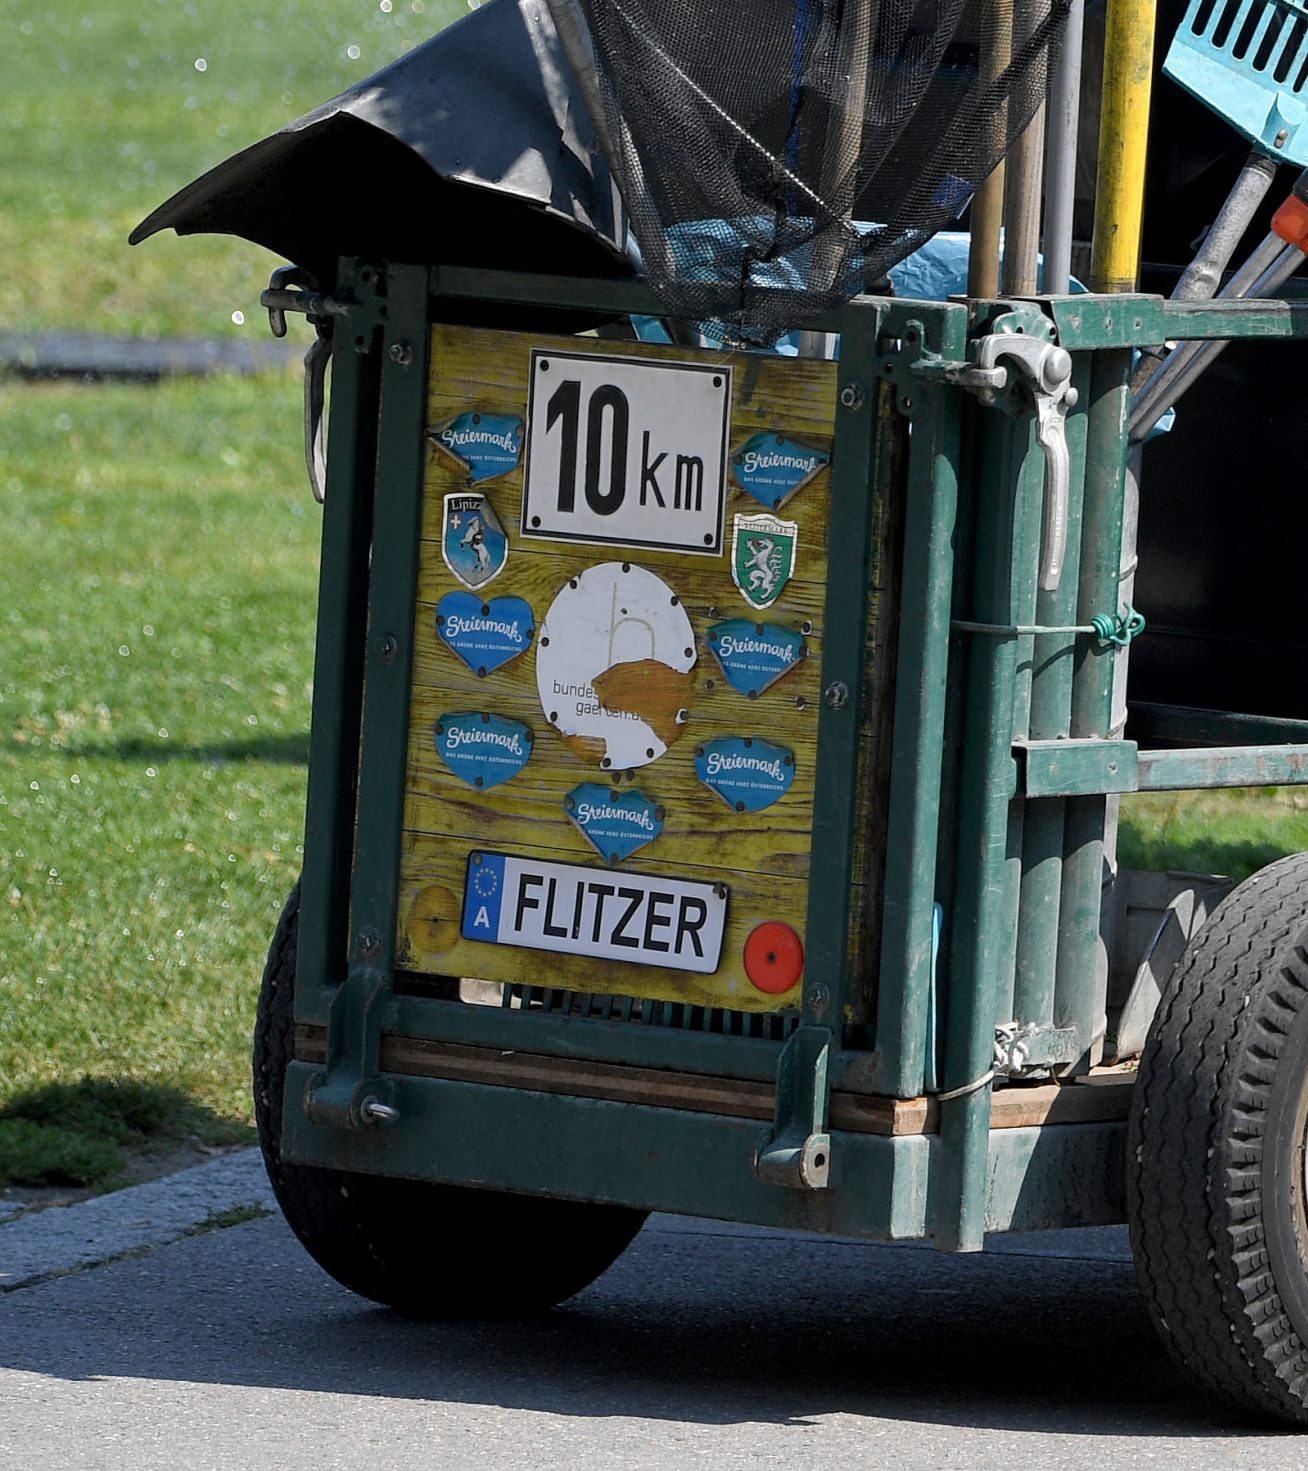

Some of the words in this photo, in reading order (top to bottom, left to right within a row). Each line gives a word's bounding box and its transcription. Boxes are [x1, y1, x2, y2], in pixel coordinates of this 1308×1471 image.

[441, 428, 517, 454] Steiermark
[545, 380, 630, 516] 10
[639, 430, 704, 512] km
[743, 450, 817, 475] Steiermark
[445, 614, 523, 644] Steiermark
[718, 635, 795, 664] Steiermark
[445, 726, 523, 756] Steiermark
[706, 752, 785, 782] Steiermark
[576, 803, 654, 831] Steiermark
[472, 905, 490, 928] A
[513, 872, 705, 958] FLITZER
